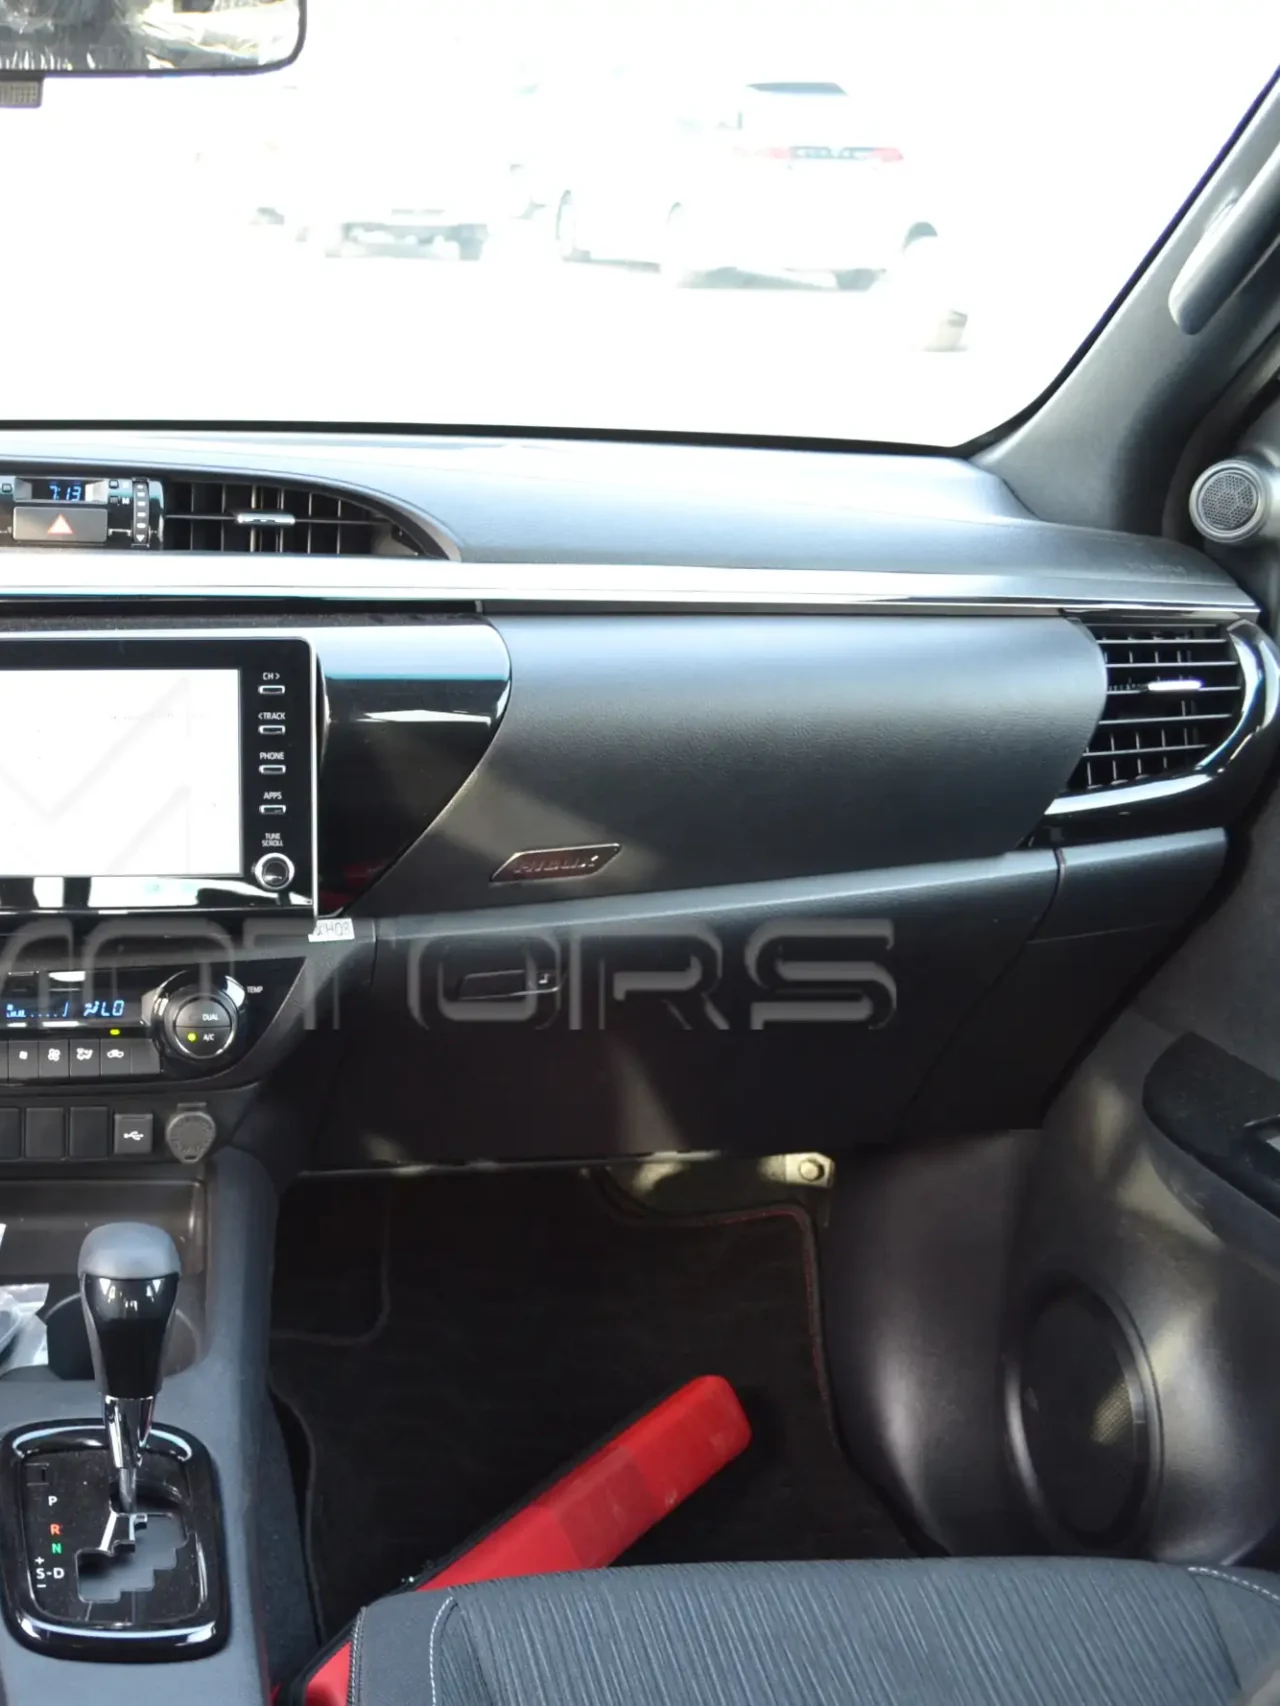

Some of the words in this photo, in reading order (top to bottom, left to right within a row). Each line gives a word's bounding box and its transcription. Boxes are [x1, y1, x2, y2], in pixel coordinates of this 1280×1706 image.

[259, 752, 285, 760] PHONE
[263, 792, 282, 800] APPS
[48, 1495, 58, 1506] P
[50, 1523, 61, 1535] R
[51, 1543, 62, 1554] N
